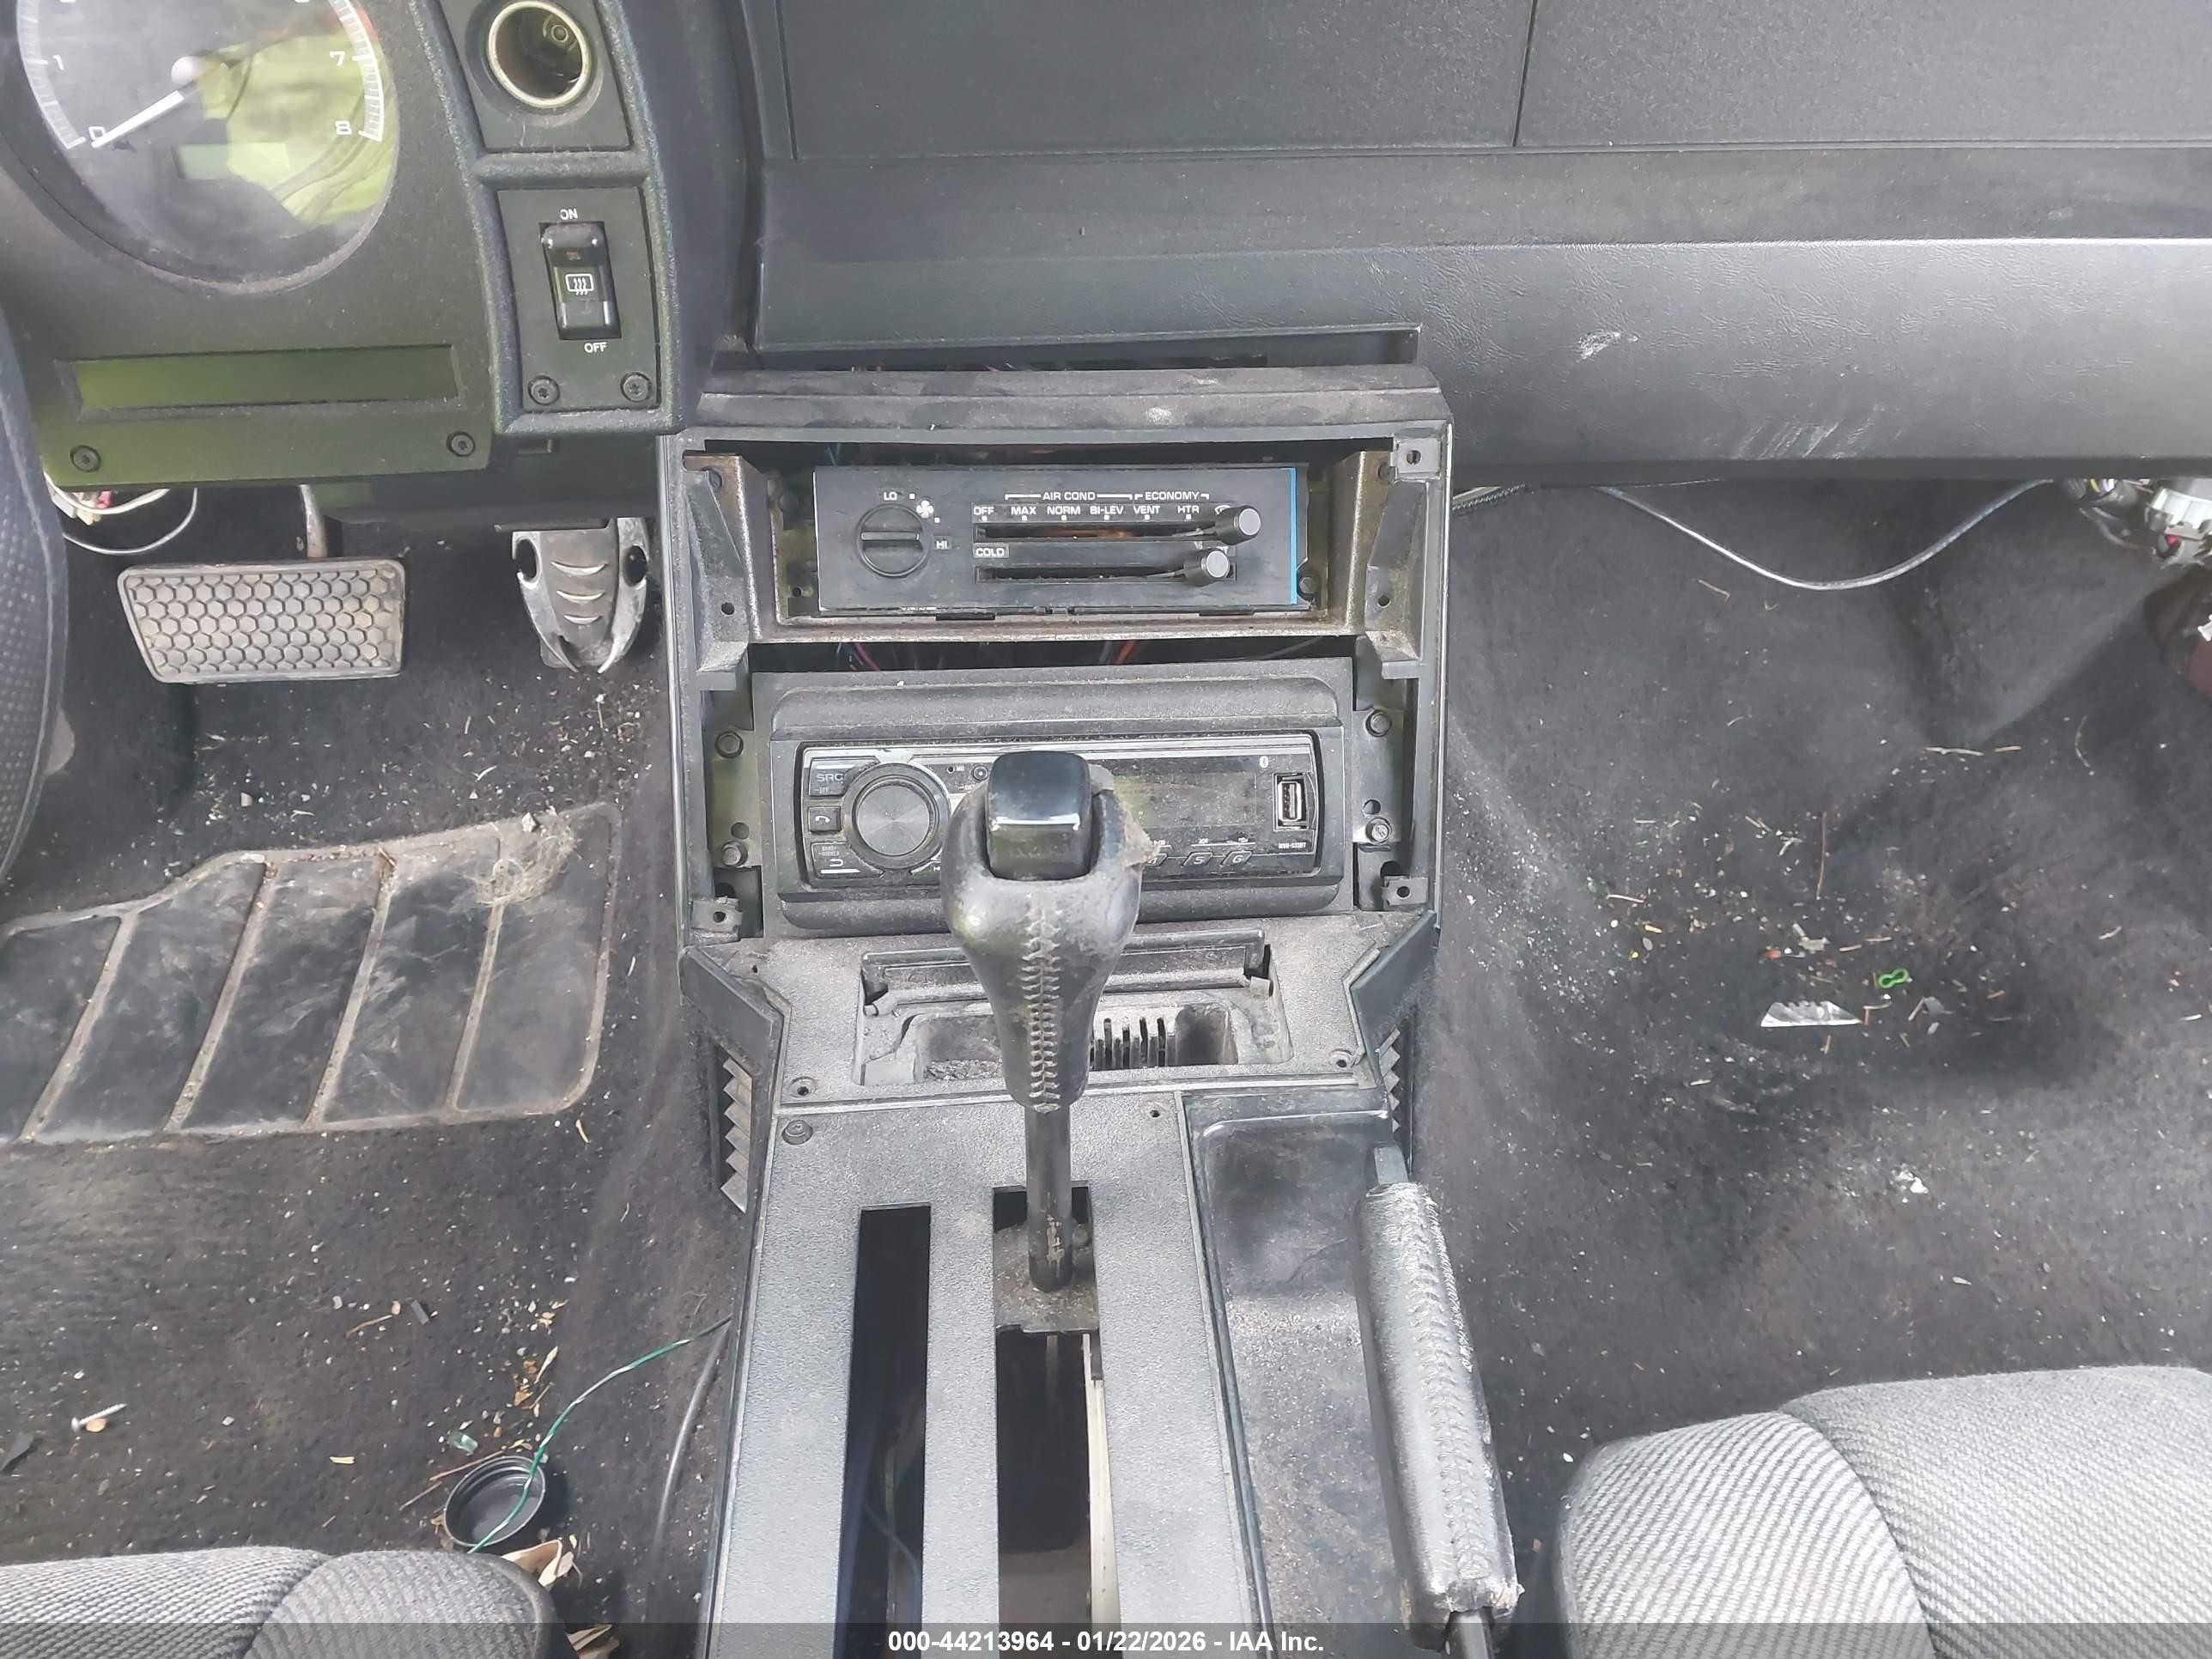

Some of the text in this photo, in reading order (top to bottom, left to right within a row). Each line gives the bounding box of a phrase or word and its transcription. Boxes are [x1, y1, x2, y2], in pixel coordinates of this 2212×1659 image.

[52, 54, 65, 70] 1
[330, 51, 345, 66] 7
[335, 120, 352, 136] 8
[560, 209, 579, 220] ON
[584, 342, 607, 353] OFF
[884, 491, 898, 501] LO
[1042, 491, 1097, 501] AIR COND
[1145, 491, 1200, 501] ECONOMY
[973, 505, 1200, 515] OFF MAX NORM BI-LEV VENT HTR
[936, 540, 949, 550] HI
[975, 548, 1005, 557] COLD
[817, 773, 843, 782] SRC
[1193, 856, 1205, 865] 5
[1232, 854, 1243, 864] 6
